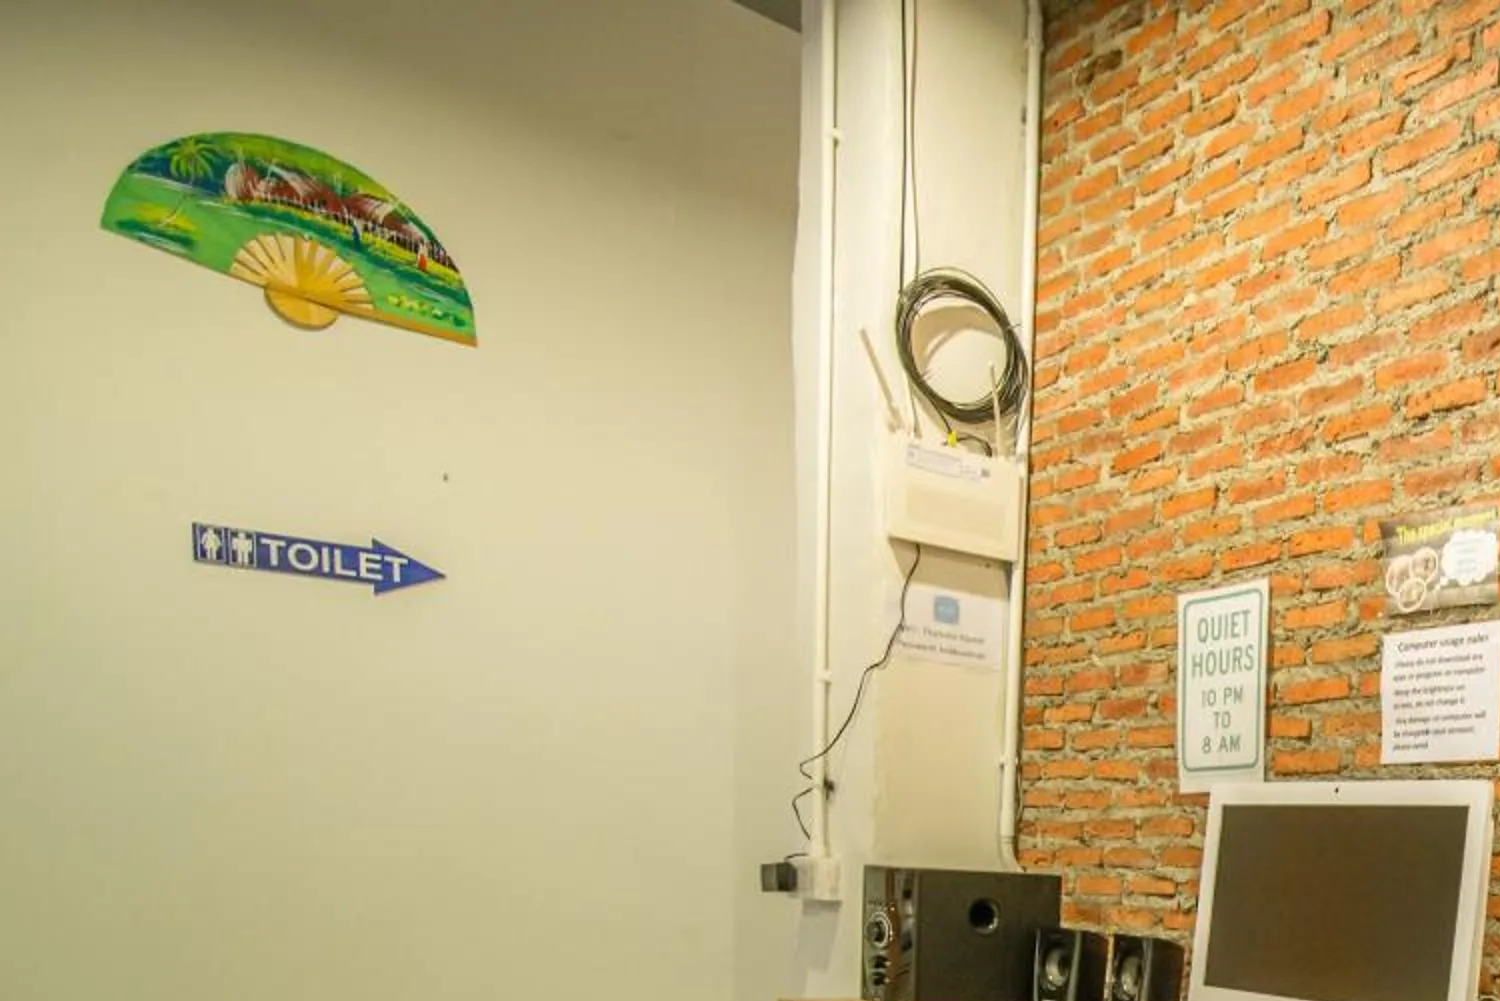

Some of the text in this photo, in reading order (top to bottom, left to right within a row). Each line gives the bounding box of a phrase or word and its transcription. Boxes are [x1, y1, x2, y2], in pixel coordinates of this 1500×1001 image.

[260, 537, 409, 583] TOILET
[1197, 610, 1251, 643] QUIET
[1397, 636, 1437, 653] Computer
[1438, 635, 1464, 648] usage
[1191, 645, 1255, 678] HOURS
[1202, 687, 1244, 708] 10 PM
[1213, 711, 1232, 729] TO
[1202, 735, 1241, 754] 8 AM
